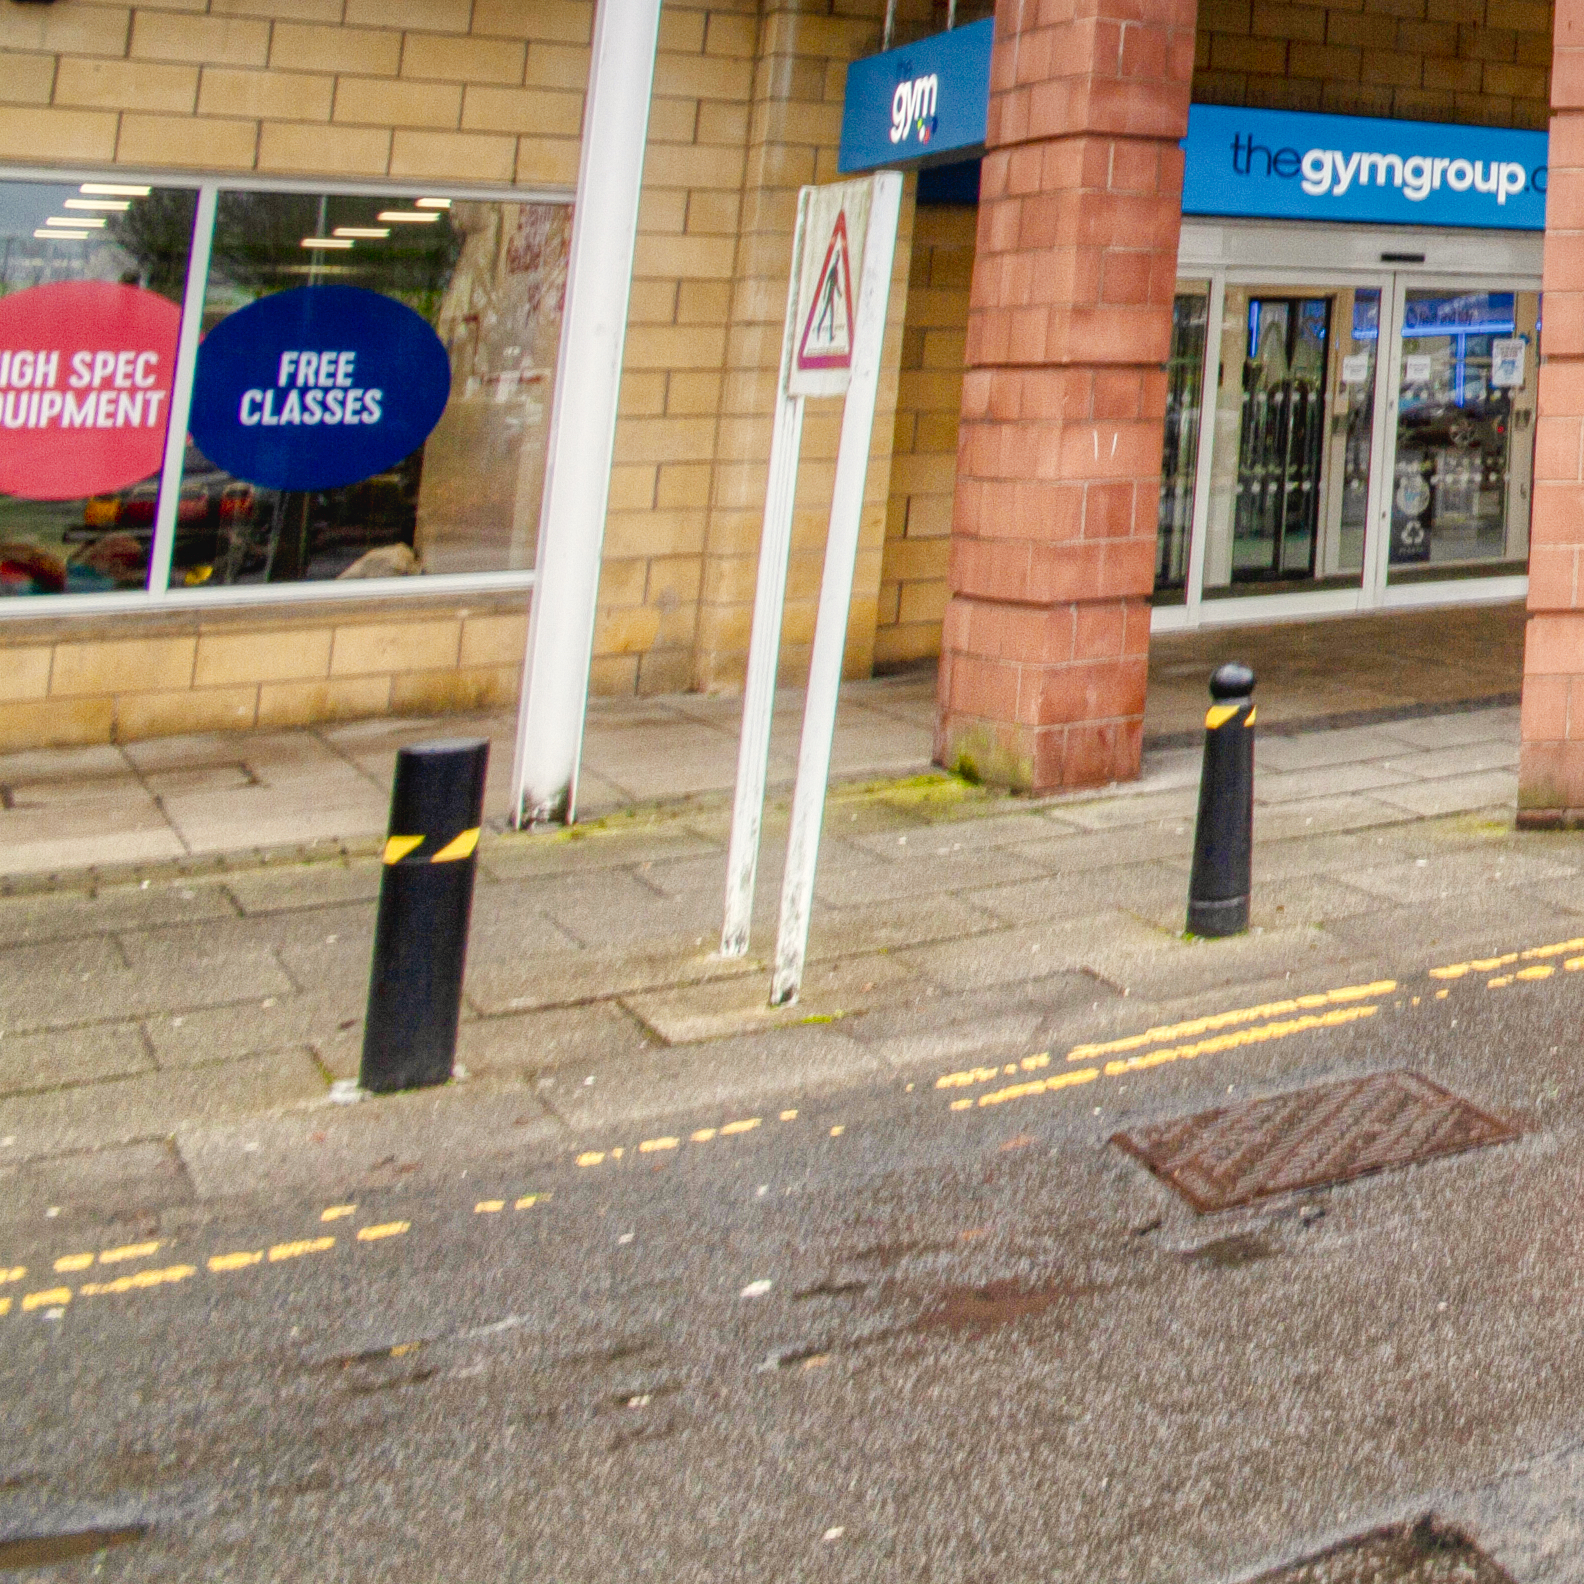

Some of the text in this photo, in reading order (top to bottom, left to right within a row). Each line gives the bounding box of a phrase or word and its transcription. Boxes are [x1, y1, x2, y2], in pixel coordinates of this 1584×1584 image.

[889, 73, 938, 144] gym
[1230, 131, 1548, 205] thegymgroup.c
[0, 349, 159, 389] IGH SPEC
[277, 350, 356, 388] FREE
[0, 390, 166, 429] UIPMENT
[238, 388, 384, 427] CLASSES
